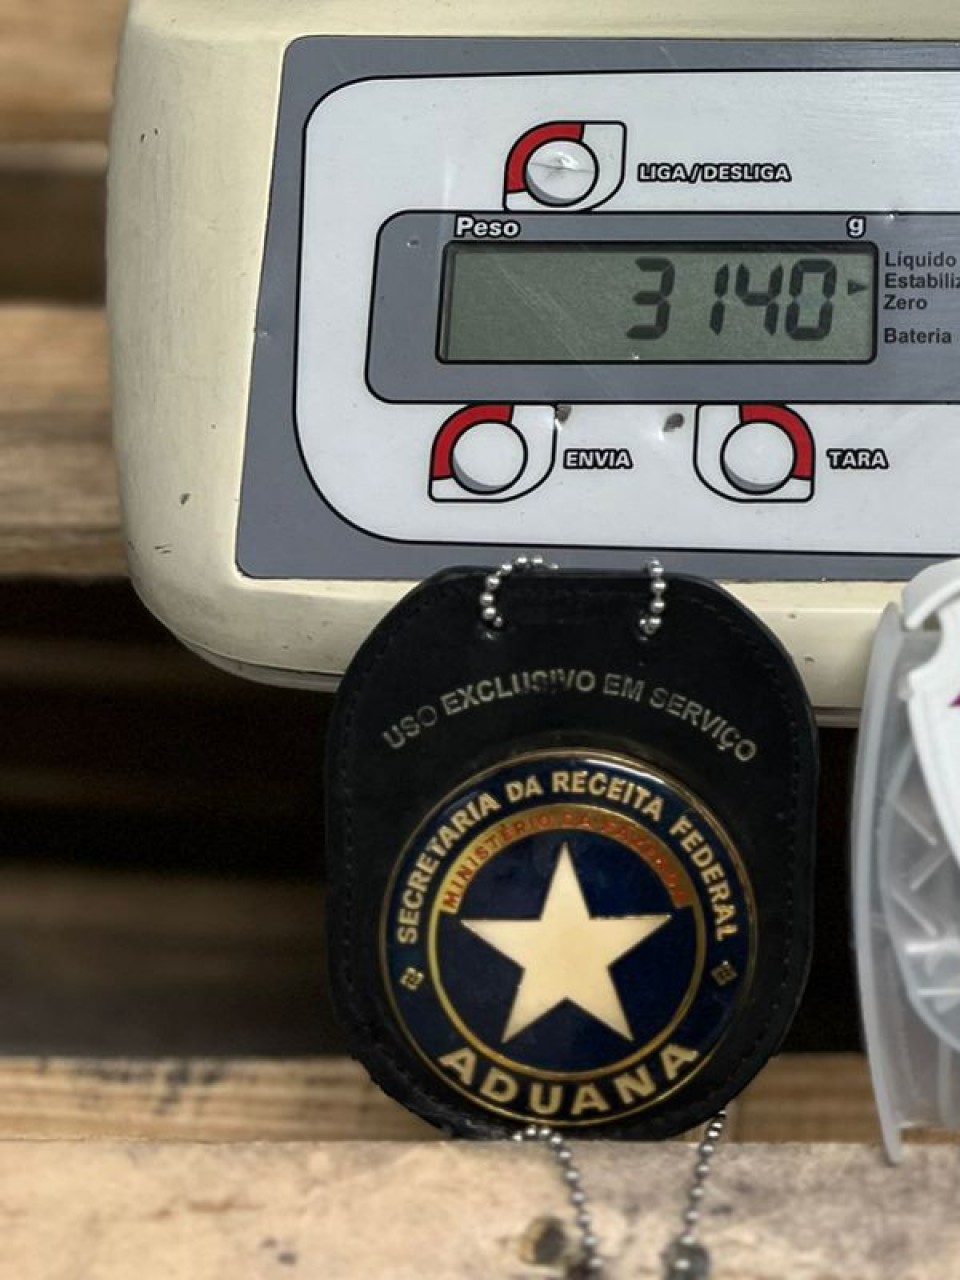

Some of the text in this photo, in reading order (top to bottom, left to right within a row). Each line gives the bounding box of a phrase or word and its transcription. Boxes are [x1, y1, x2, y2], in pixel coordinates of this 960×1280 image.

[455, 216, 521, 238] Peso
[846, 216, 865, 238] g
[884, 251, 957, 270] Líquido
[626, 257, 838, 342] 3140
[883, 293, 928, 310] Zero
[883, 327, 952, 344] Bateria
[563, 449, 633, 470] ENVIA
[828, 449, 890, 470] TARA
[383, 668, 759, 763] USO EXCLUSIVO EM SERVIÇO
[397, 770, 739, 945] SECRETARIA DA RECEITA FEDERAL
[438, 1043, 700, 1116] ADUANA
